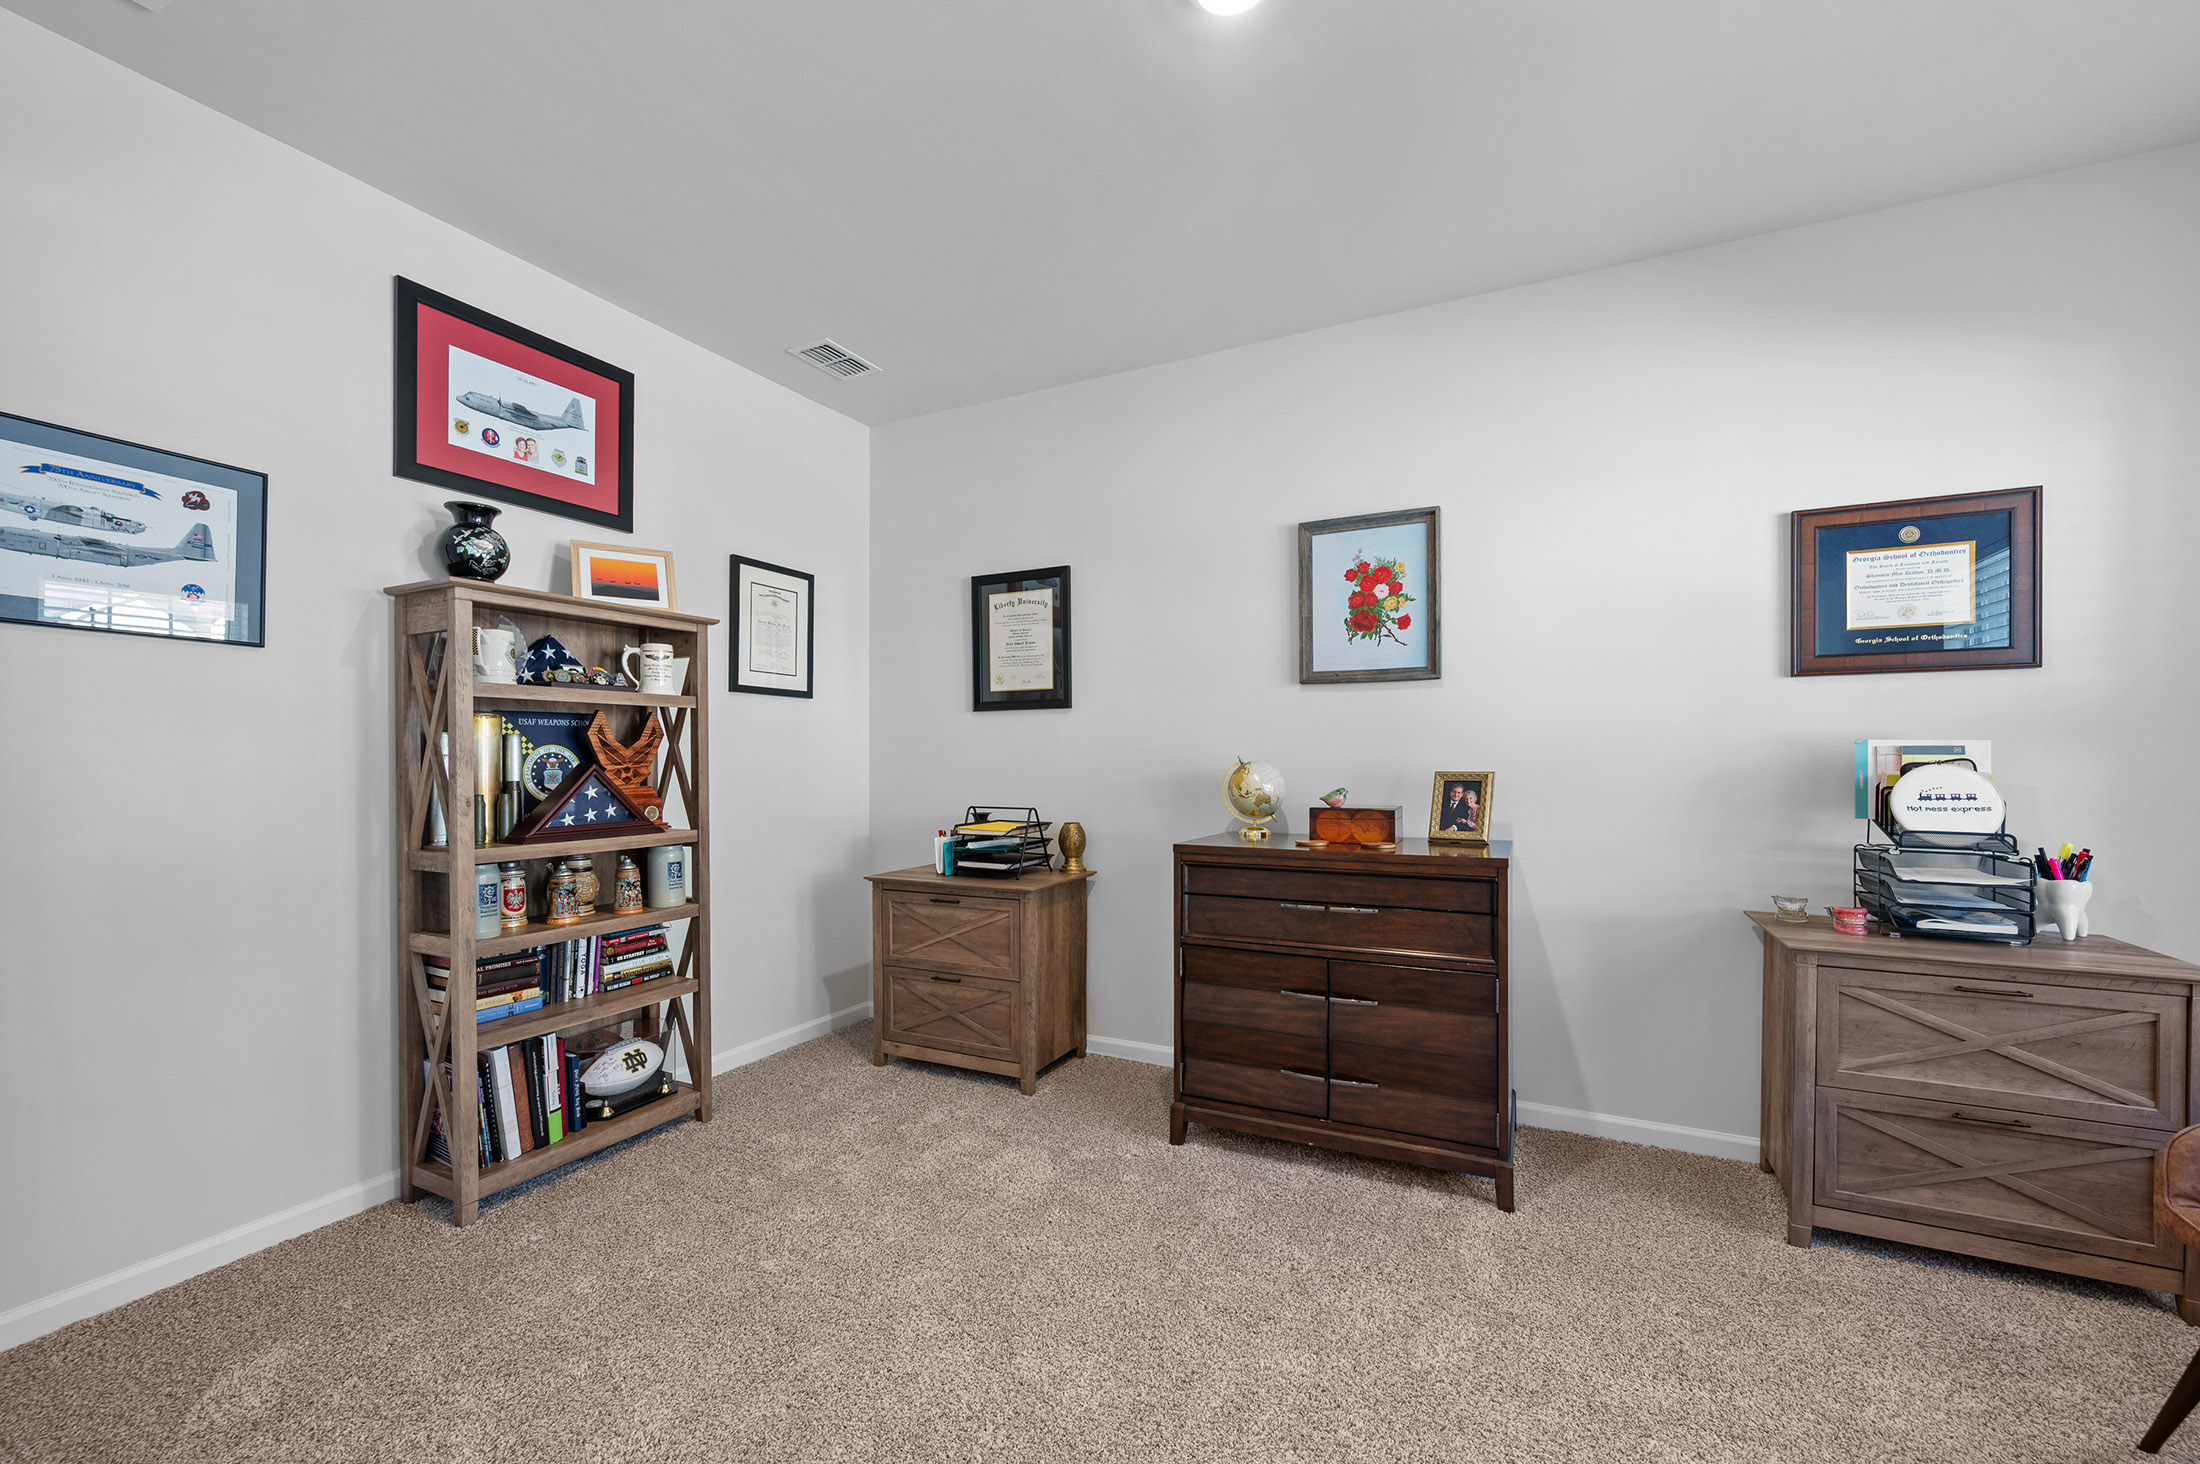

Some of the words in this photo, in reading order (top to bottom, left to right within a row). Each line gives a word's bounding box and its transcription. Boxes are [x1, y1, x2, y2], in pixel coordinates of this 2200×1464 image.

[77, 472, 136, 489] ANNIVERSARY
[1919, 549, 1966, 557] Orthodontics
[1855, 637, 1882, 645] Georgia
[1884, 635, 1909, 644] School
[1920, 633, 1968, 641] Orthodontics
[518, 718, 536, 726] USAF
[571, 719, 590, 727] SCHO
[1951, 806, 1992, 814] express
[485, 961, 512, 971] PROMISES
[622, 966, 654, 978] Wooden
